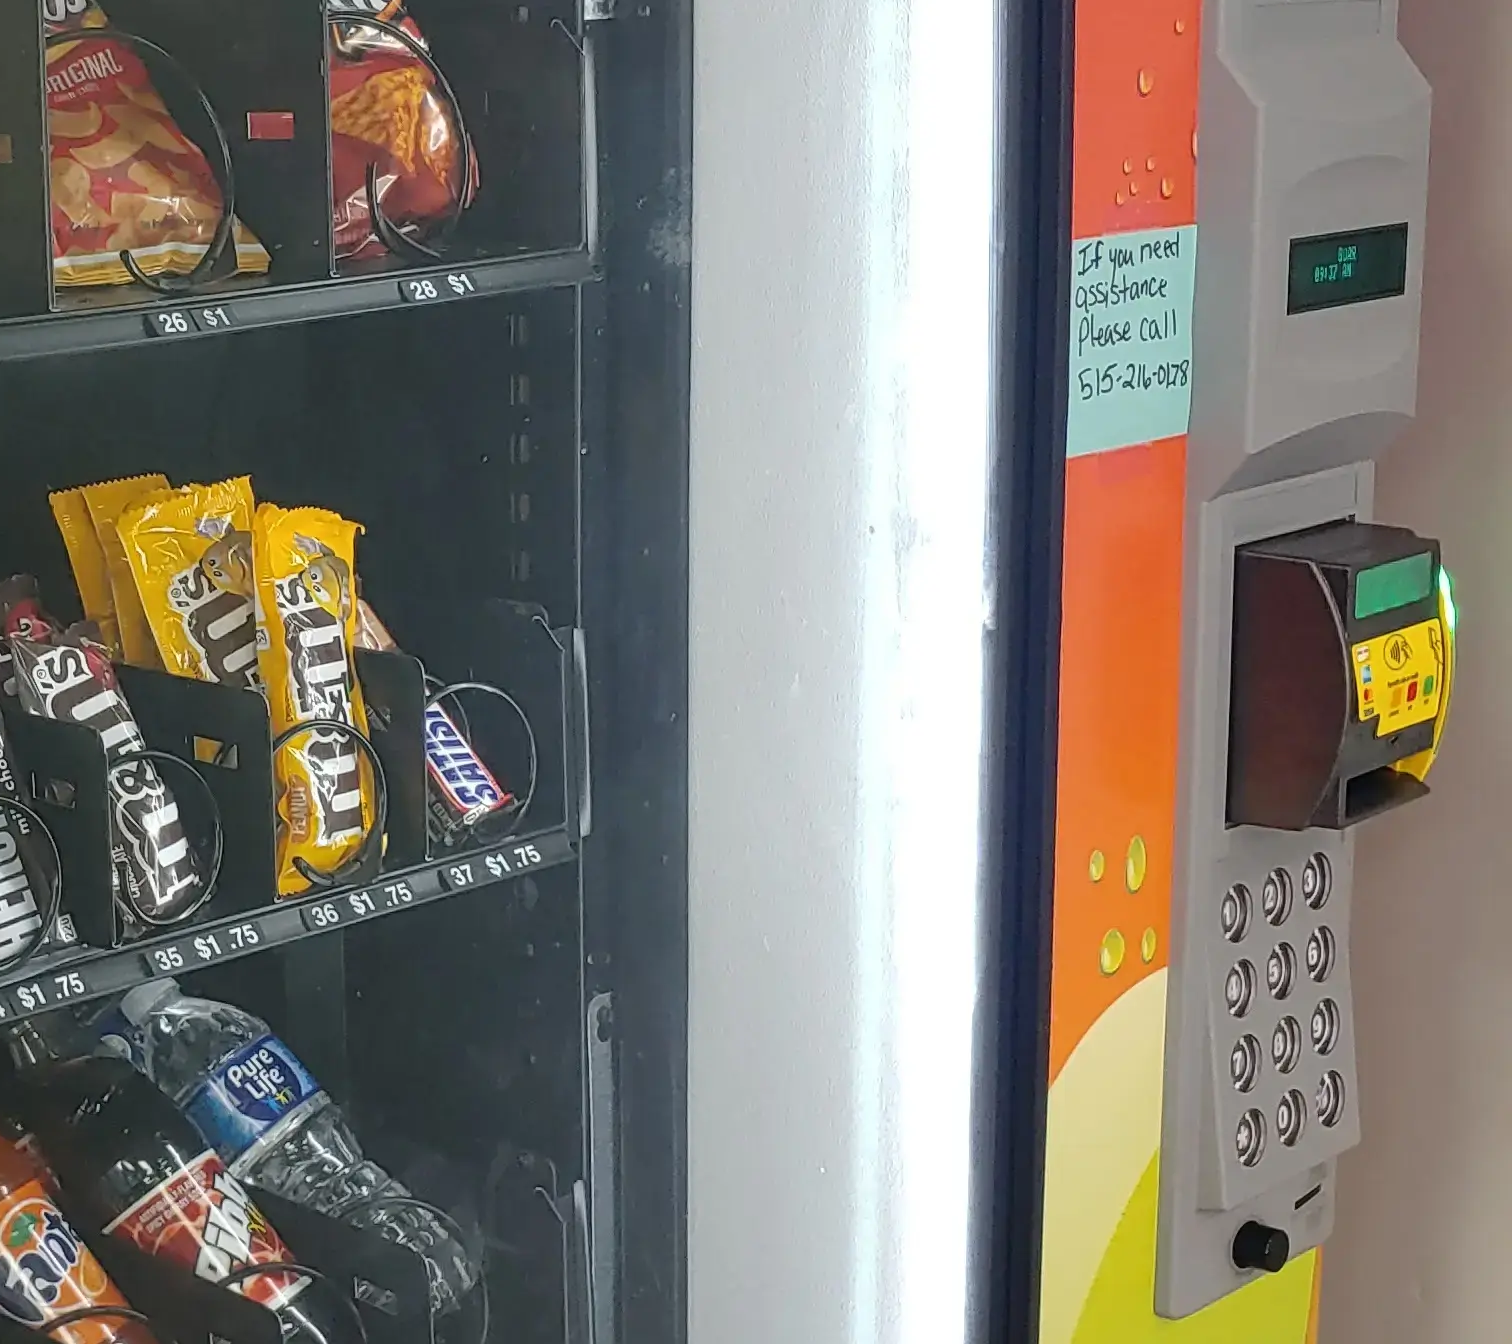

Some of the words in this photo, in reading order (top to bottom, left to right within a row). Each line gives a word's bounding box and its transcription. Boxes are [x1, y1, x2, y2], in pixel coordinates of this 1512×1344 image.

[1076, 243, 1106, 277] If
[1107, 246, 1136, 288] you
[1139, 231, 1180, 263] need
[408, 280, 438, 300] 28
[449, 274, 476, 296] $1
[1074, 275, 1169, 311] assistance
[157, 312, 188, 335] 26
[202, 307, 232, 328] $1
[1076, 314, 1133, 358] Please
[1139, 309, 1178, 339] call
[1078, 358, 1190, 401] 515-216-0178
[287, 783, 313, 844] PEANUT
[449, 864, 475, 887] 37
[486, 854, 510, 876] $1
[513, 845, 542, 869] .75
[311, 903, 340, 928] 36
[352, 892, 377, 916] $1
[384, 883, 413, 908] .75
[1265, 885, 1276, 906] 2
[1303, 870, 1313, 890] 3
[155, 947, 184, 971] 35
[193, 934, 222, 959] $1
[230, 925, 260, 949] .75
[1269, 959, 1279, 981] 5
[1308, 941, 1318, 964] 6
[17, 985, 47, 1011] $1
[55, 973, 86, 1001] .75
[1234, 1051, 1245, 1073] 7
[1273, 1033, 1284, 1056] 8
[1312, 1015, 1323, 1037] 9
[228, 1046, 274, 1089] Pure
[244, 1065, 286, 1101] Life
[1279, 1107, 1289, 1129] 0
